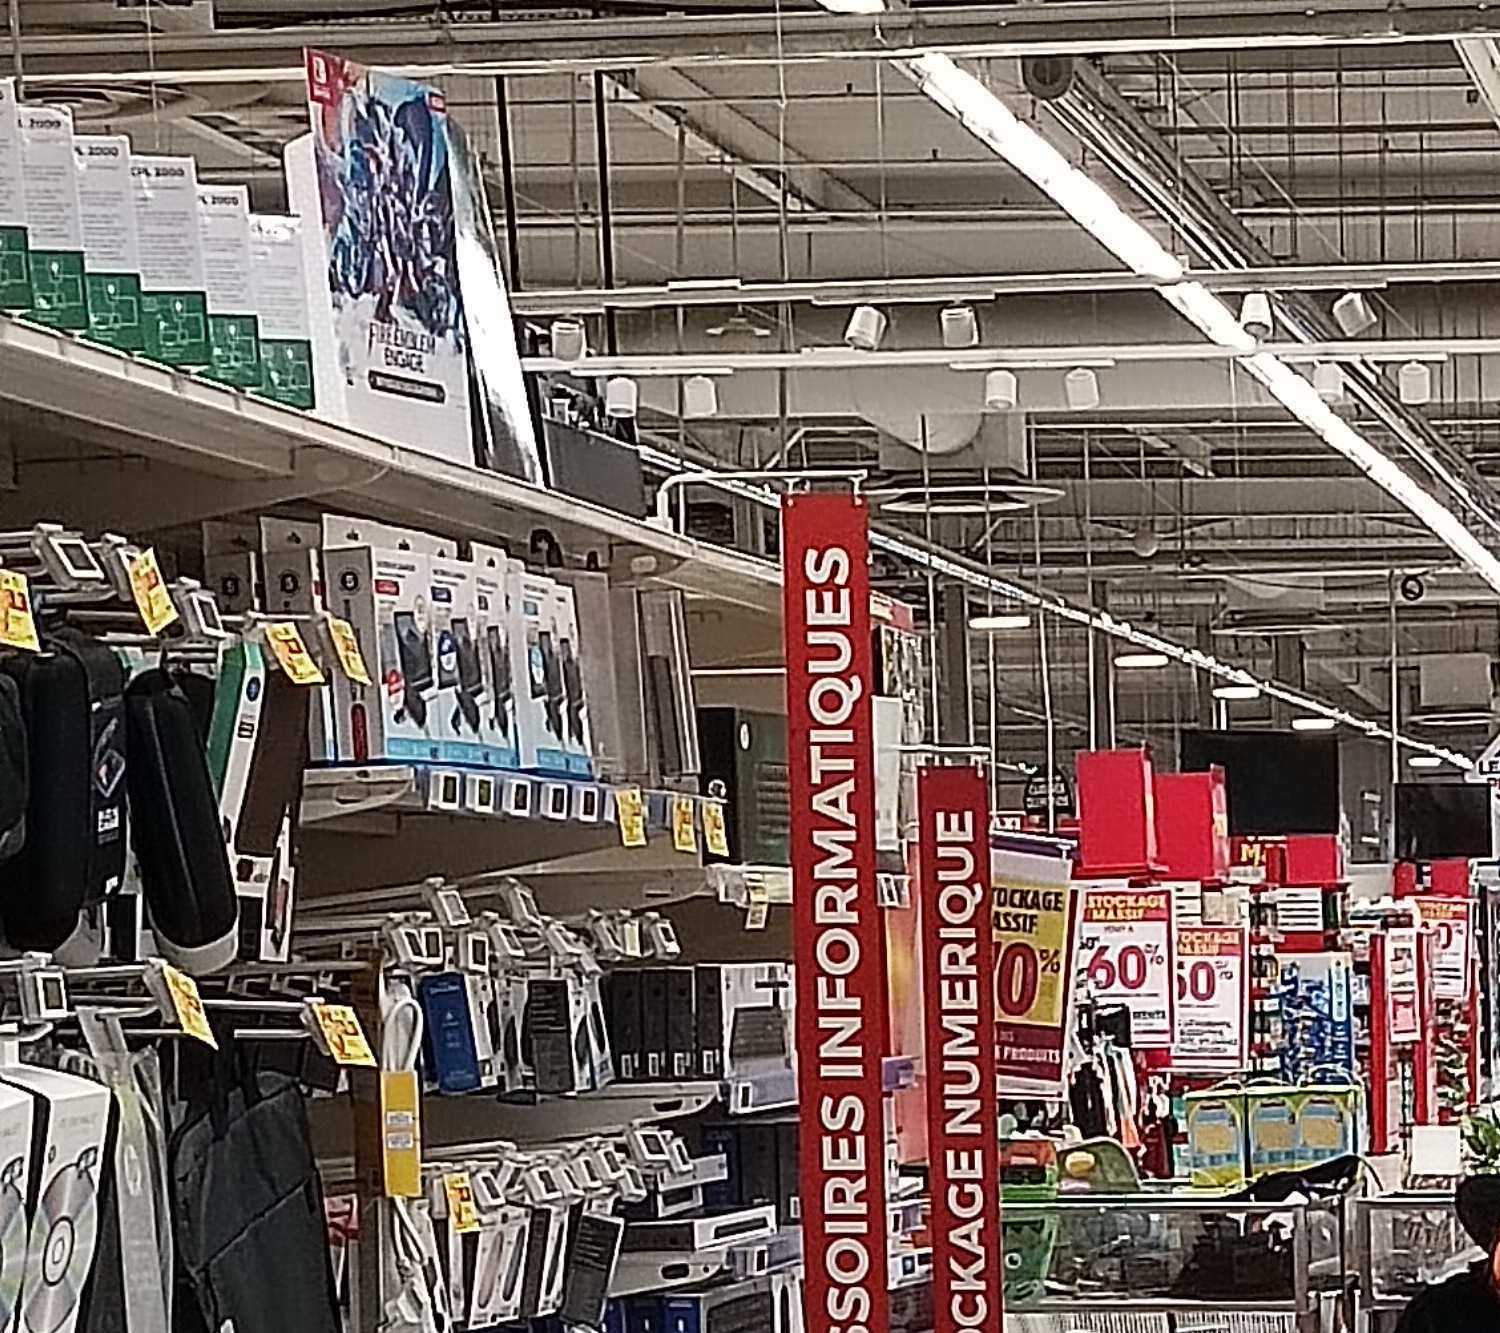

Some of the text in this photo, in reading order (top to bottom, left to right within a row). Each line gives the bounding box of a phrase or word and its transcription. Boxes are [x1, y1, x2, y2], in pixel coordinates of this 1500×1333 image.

[804, 546, 864, 1078] INFORMATIQUES
[935, 809, 984, 1137] NUMERIQUE
[993, 941, 1061, 1015] 0%
